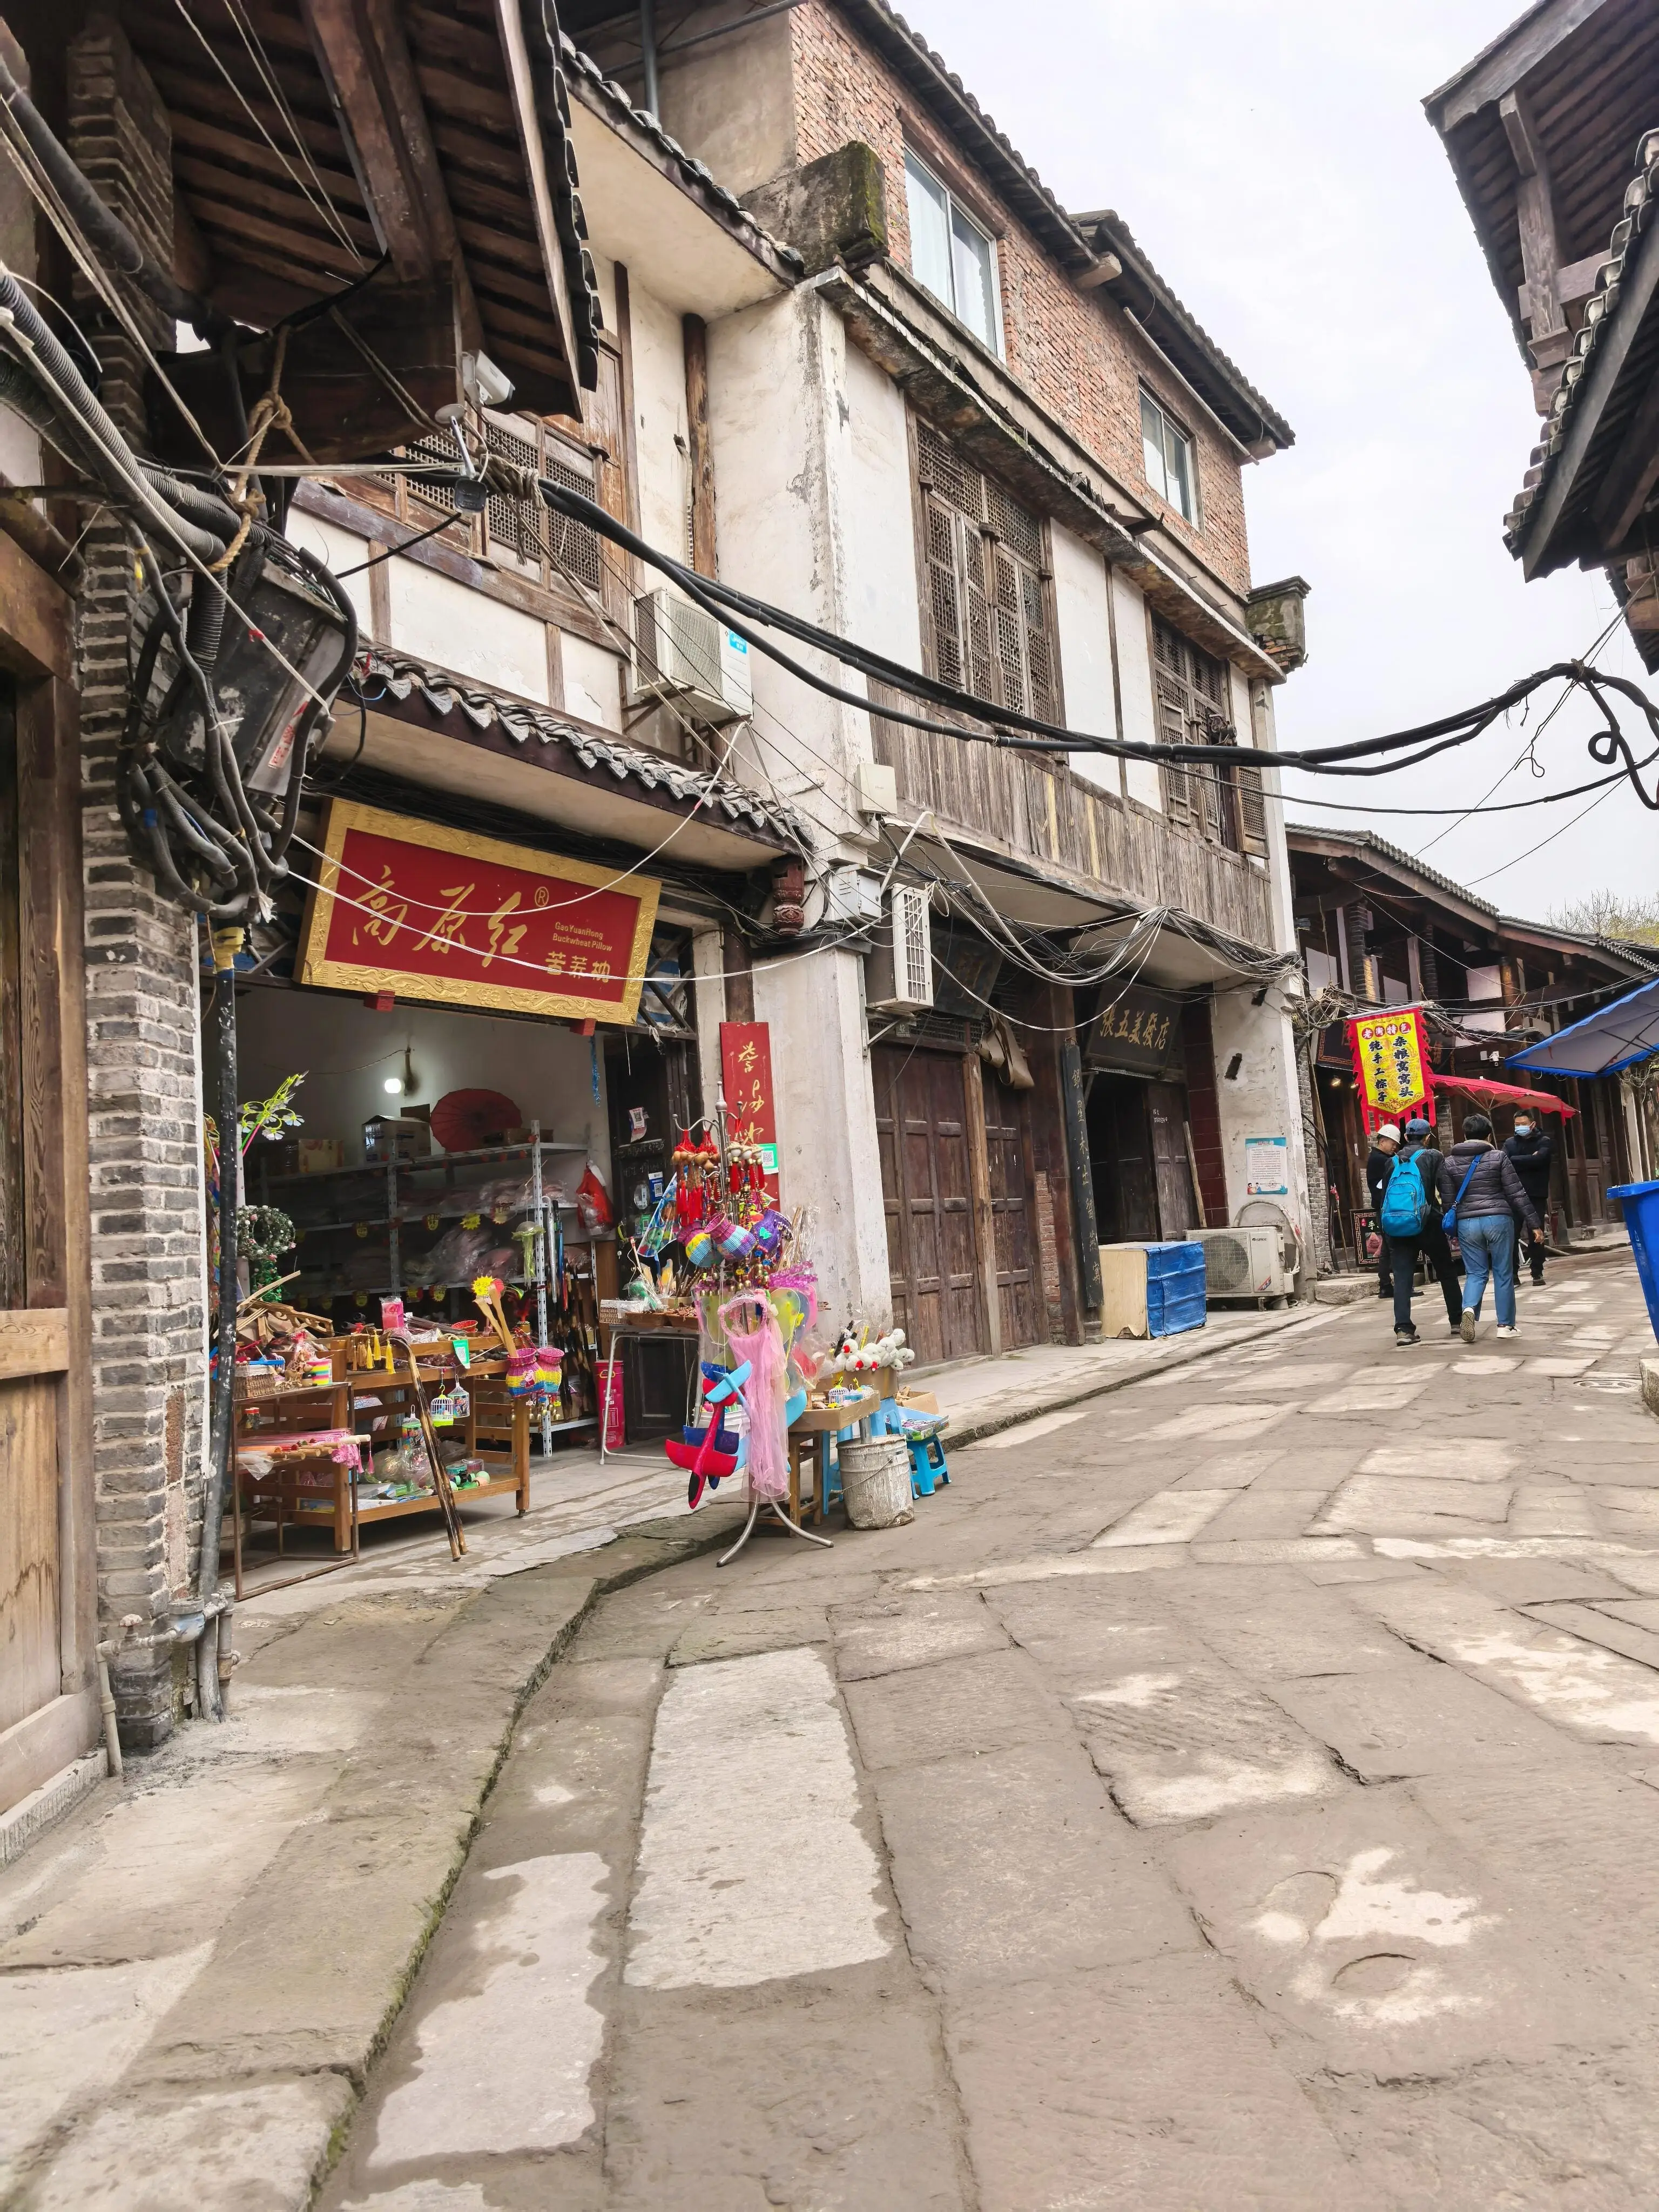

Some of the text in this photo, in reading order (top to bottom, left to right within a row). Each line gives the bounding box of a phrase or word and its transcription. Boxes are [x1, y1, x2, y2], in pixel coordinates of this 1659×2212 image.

[352, 865, 527, 967] 高原红
[552, 933, 612, 951] Buckwheat Pillow
[1363, 1022, 1411, 1038] 老街特色
[1369, 1040, 1387, 1102] 纯手工粽子
[1393, 1036, 1414, 1097] 杂粮窝窝头
